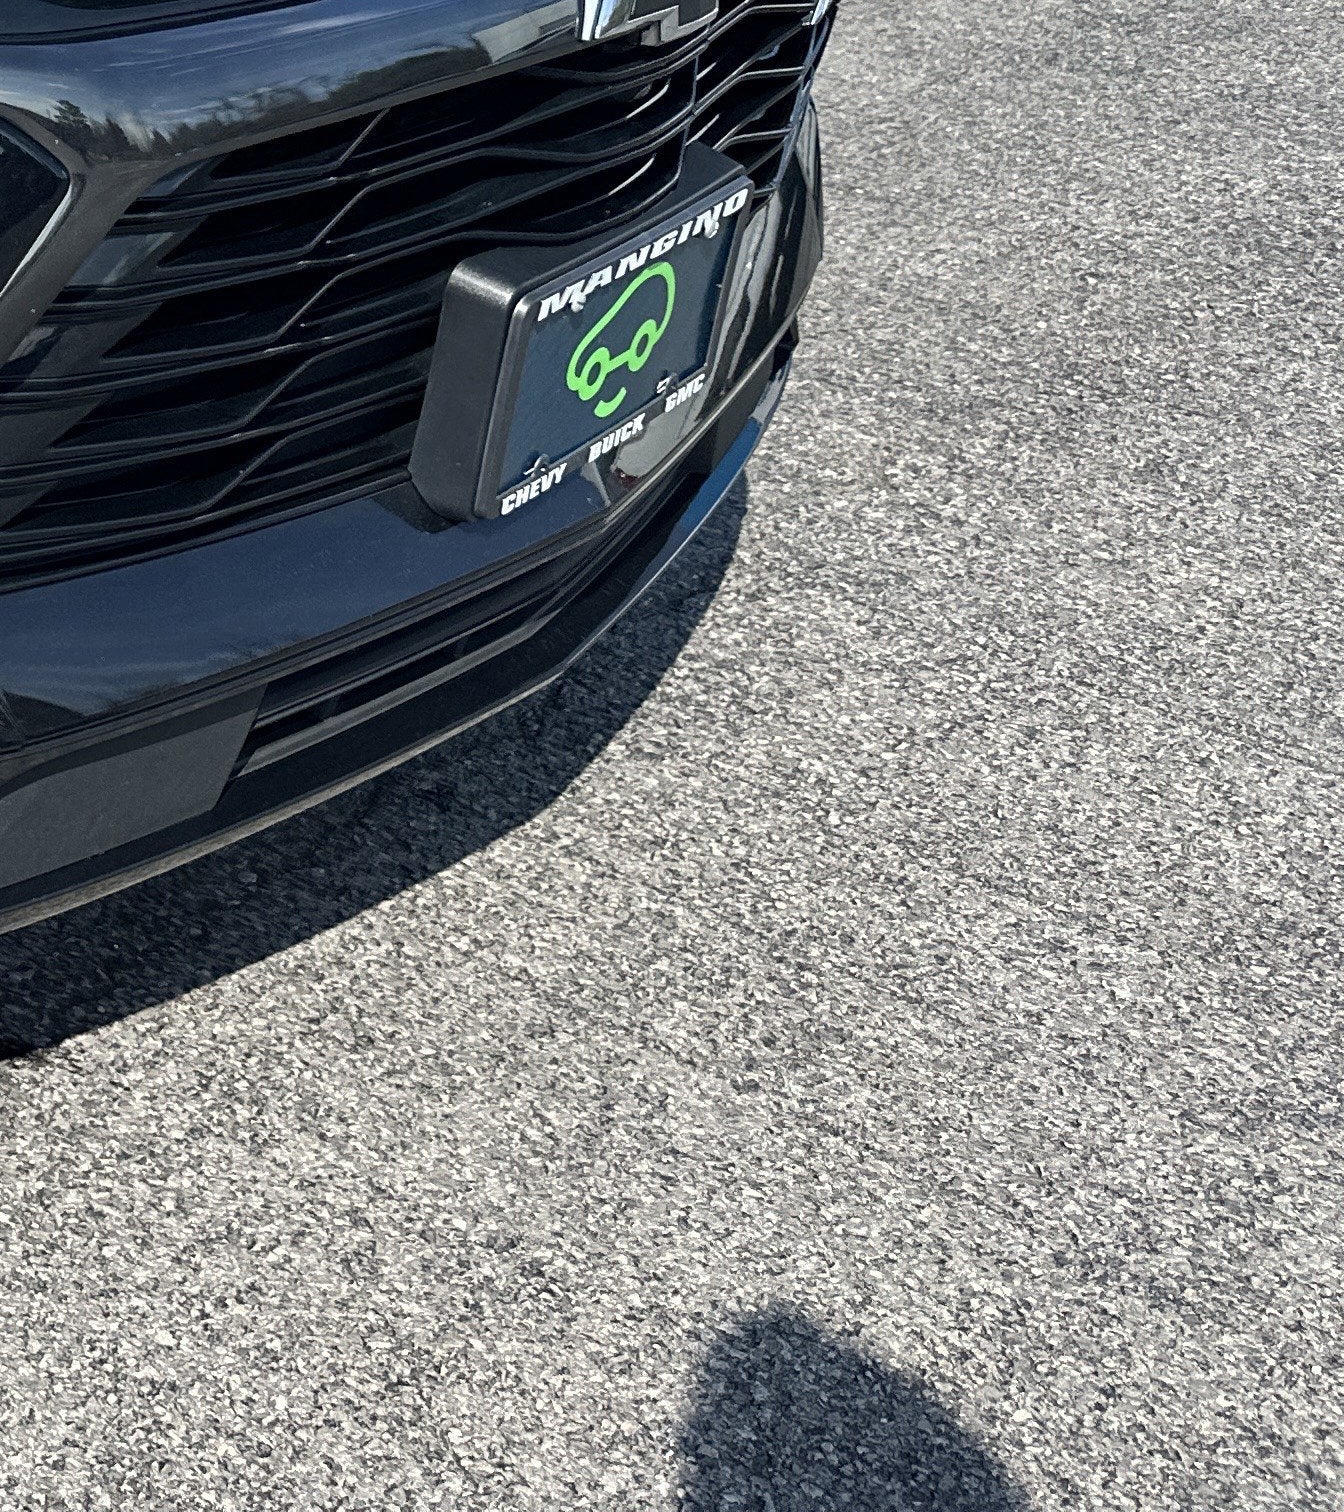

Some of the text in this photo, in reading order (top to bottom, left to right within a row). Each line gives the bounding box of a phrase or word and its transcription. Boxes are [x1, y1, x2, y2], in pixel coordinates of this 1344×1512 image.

[537, 188, 749, 323] MANGINO
[499, 461, 568, 517] CHEVY
[587, 411, 645, 464] BUICK
[664, 373, 706, 413] GMC
